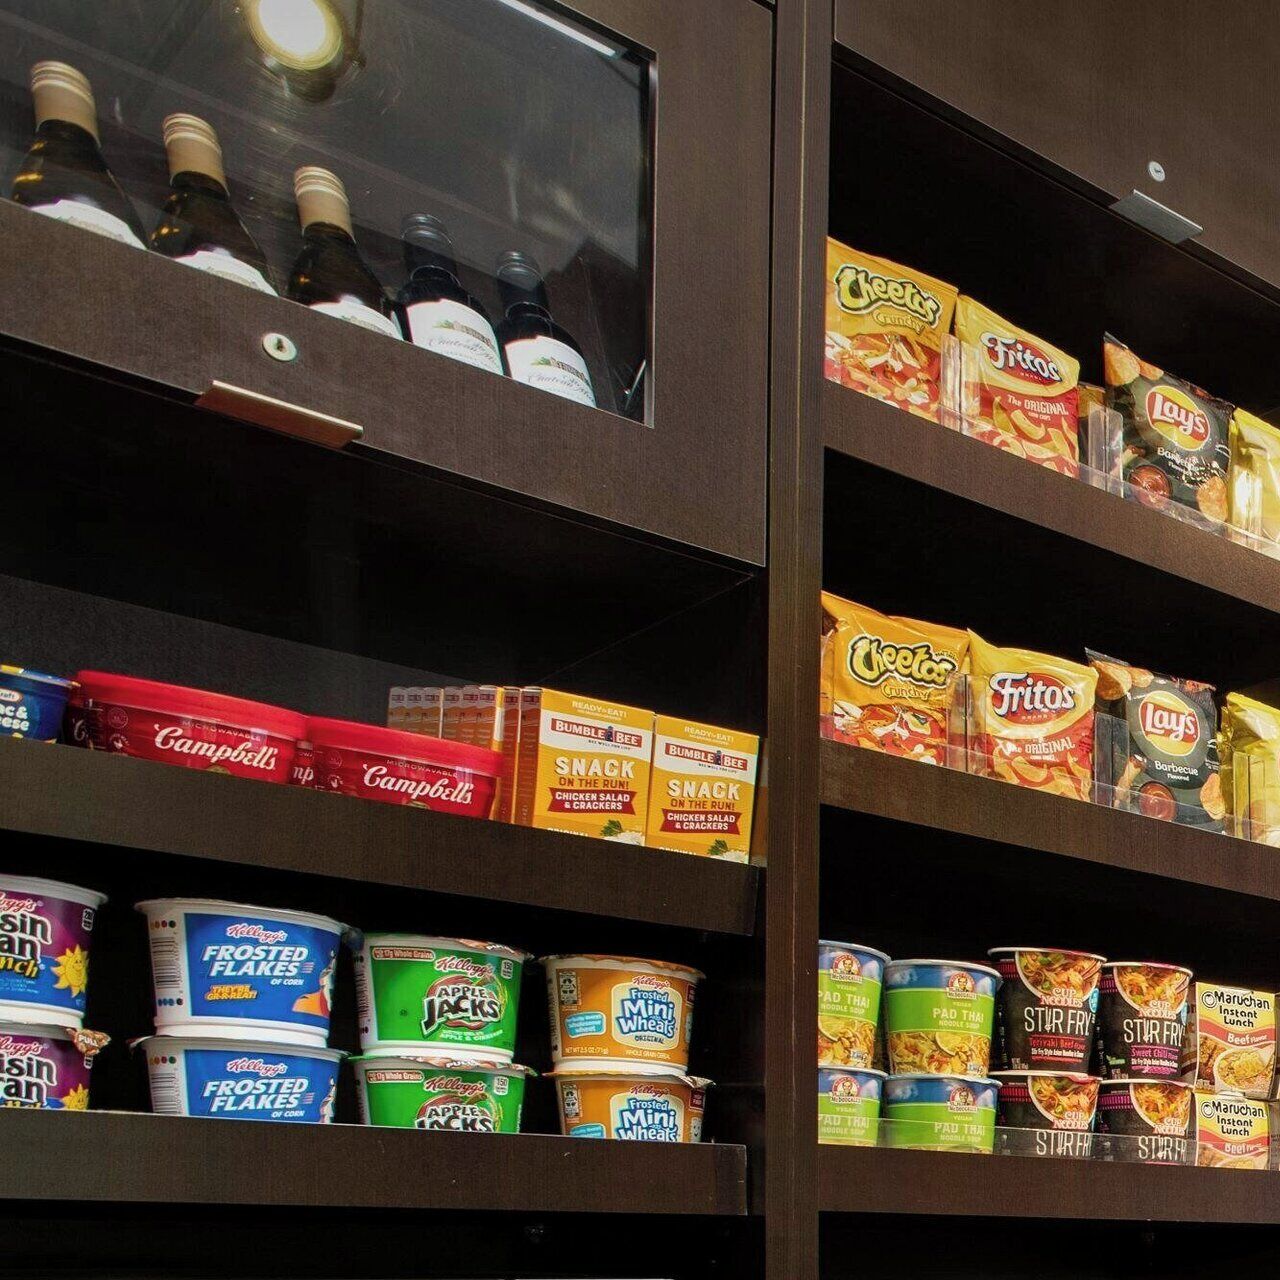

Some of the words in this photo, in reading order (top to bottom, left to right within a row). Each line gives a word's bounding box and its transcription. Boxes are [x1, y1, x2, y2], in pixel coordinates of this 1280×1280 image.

[837, 267, 941, 323] Cheetos
[981, 332, 1062, 382] Fritos
[1024, 398, 1069, 416] ORIGINAL
[1152, 394, 1206, 437] Lay's
[851, 636, 956, 686] Cheetos
[883, 682, 930, 700] Crunchy
[990, 672, 1075, 716] Fritos
[1145, 703, 1198, 741] Lay's
[555, 721, 604, 739] BUMBLE
[617, 732, 639, 746] BEE
[154, 723, 278, 771] Campbell's
[1025, 737, 1075, 755] ORIGINAL
[669, 744, 714, 763] BUMBLE
[724, 755, 745, 769] BEE
[555, 757, 635, 779] SNACK
[1155, 760, 1198, 775] Barbecue
[363, 763, 473, 805] Campbell's
[559, 777, 575, 787] ON
[579, 778, 599, 788] THE
[603, 779, 629, 790] RUN!
[667, 779, 740, 800] SNACK
[555, 791, 597, 801] CHICKEN
[600, 793, 630, 802] SALAD
[573, 801, 622, 810] CRACKERS
[671, 798, 686, 808] ON
[689, 799, 708, 809] THE
[711, 800, 735, 811] RUN!
[667, 813, 705, 822] CHICKEN
[707, 814, 735, 823] SALAD
[683, 821, 728, 831] CRACKERS
[227, 923, 288, 943] Kellogg's
[203, 945, 308, 962] FROSTED
[210, 961, 300, 978] FLAKES
[436, 957, 493, 977] Kellogg's
[438, 986, 487, 998] APPLE
[632, 990, 668, 1002] Frosted
[847, 994, 870, 1008] THAI
[1053, 987, 1076, 998] CUP
[1214, 991, 1270, 1010] Maruchan
[622, 999, 675, 1020] Mini
[1040, 995, 1083, 1008] NOODLES
[422, 996, 500, 1034] JACKS
[933, 1007, 957, 1020] PAD
[962, 1010, 984, 1023] THAI
[1219, 1005, 1257, 1018] Instant
[618, 1017, 677, 1038] Wheats
[938, 1019, 965, 1028] NOODLE
[1024, 1006, 1064, 1033] STIR
[1067, 1009, 1092, 1036] FRY
[1224, 1016, 1254, 1027] Lunch
[1123, 1019, 1160, 1043] STIR
[1164, 1021, 1184, 1047] FRY
[1227, 1033, 1250, 1044] Beef
[227, 1058, 288, 1077] Kellogg's
[204, 1078, 308, 1096] FROSTED
[425, 1077, 487, 1095] Kellogg's
[630, 1086, 670, 1098] Kellogg's
[211, 1095, 300, 1113] FLAKES
[428, 1105, 477, 1118] APPLE
[630, 1099, 668, 1111] Frosted
[1212, 1101, 1265, 1118] Maruchan
[622, 1110, 676, 1129] Mini
[847, 1115, 870, 1129] THAI
[1217, 1115, 1253, 1127] Instant
[935, 1122, 959, 1135] PAD
[964, 1124, 985, 1137] THAI
[1222, 1126, 1250, 1136] Lunch
